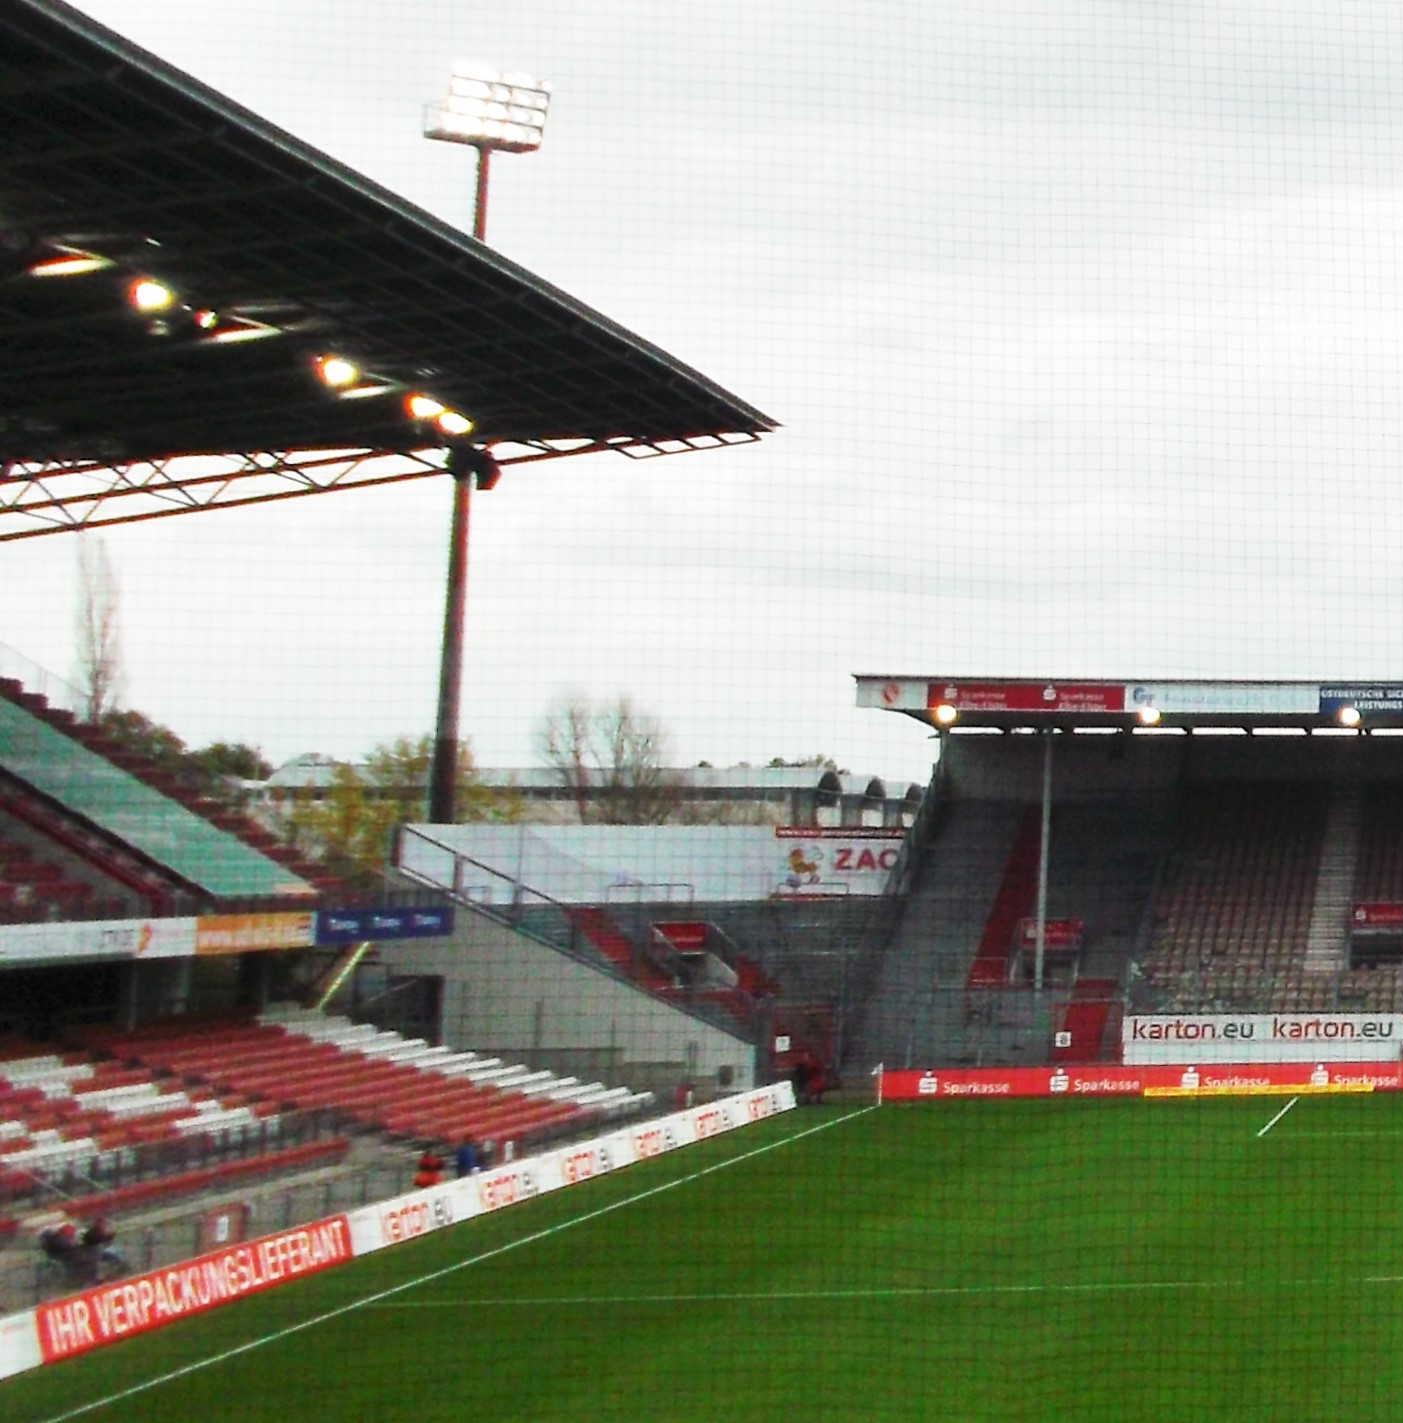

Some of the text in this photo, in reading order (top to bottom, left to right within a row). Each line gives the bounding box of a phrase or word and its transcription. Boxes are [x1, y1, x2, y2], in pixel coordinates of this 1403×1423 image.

[1132, 1018, 1254, 1039] karton.eu
[1272, 1017, 1393, 1039] karton.eu
[943, 1081, 1010, 1096] Sparkasse
[1074, 1078, 1140, 1094] Sparkasse
[45, 1222, 348, 1355] IHR VERPACKUNGSLIEFERANT
